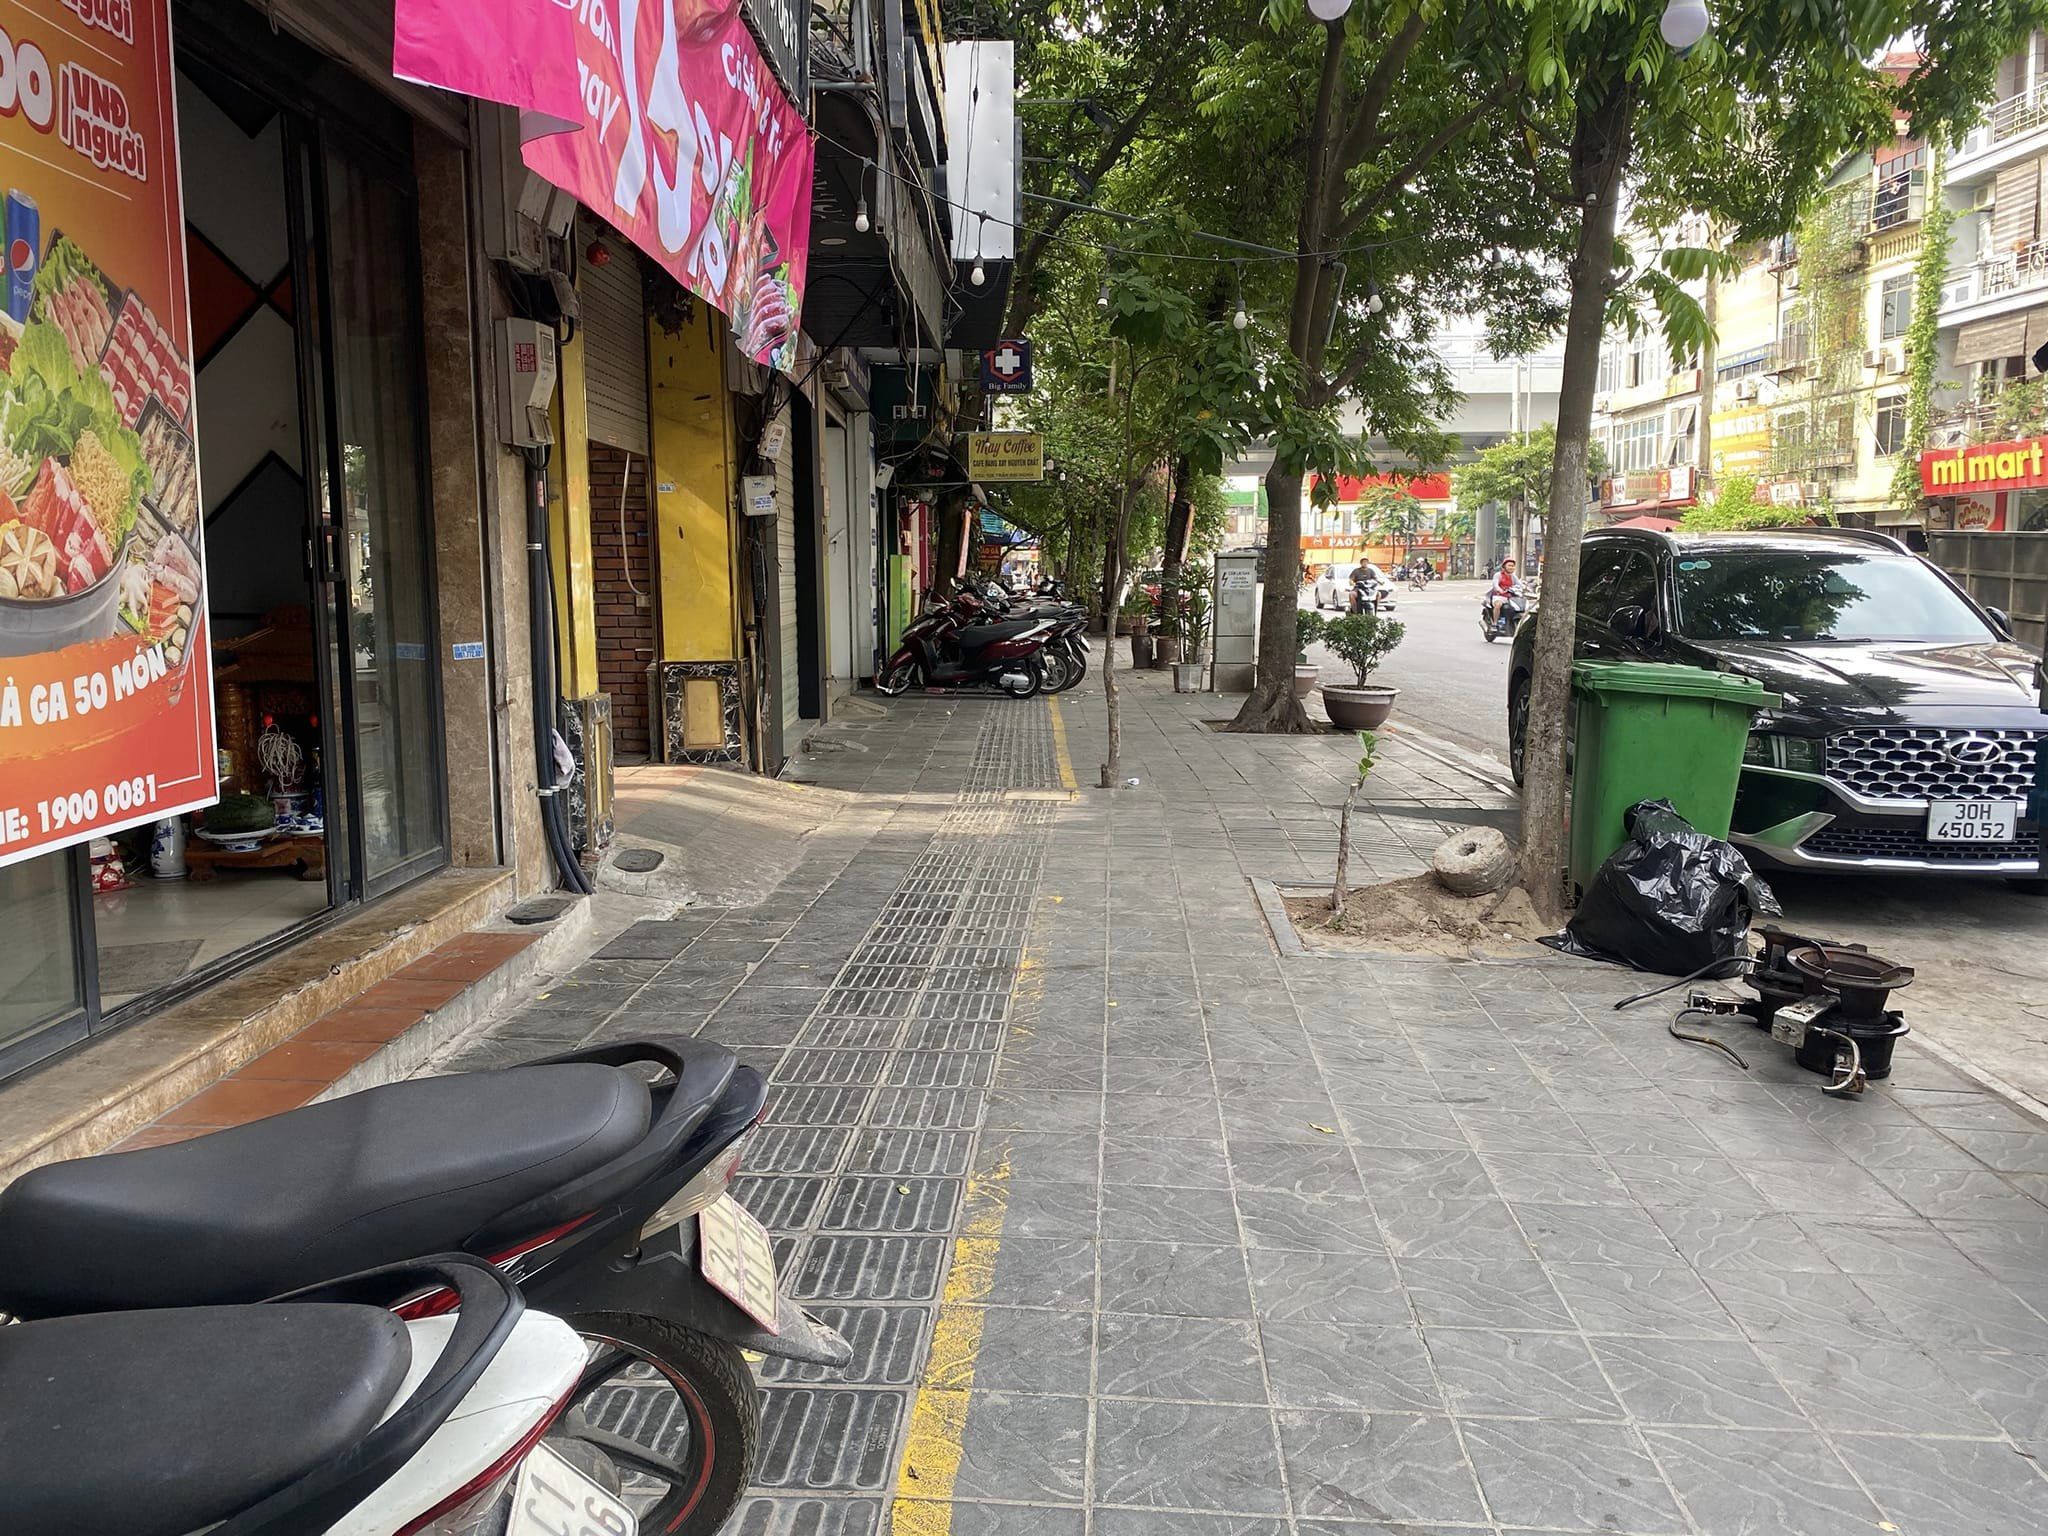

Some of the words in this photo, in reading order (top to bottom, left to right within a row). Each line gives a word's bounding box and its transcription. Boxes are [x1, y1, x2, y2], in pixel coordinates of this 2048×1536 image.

[74, 113, 147, 181] người
[988, 382, 1001, 391] Big
[1003, 382, 1027, 391] Family
[1004, 438, 1036, 456] Coffee
[30, 681, 69, 726] GA
[73, 672, 108, 715] 50
[111, 642, 168, 702] MÓN
[37, 788, 99, 834] 1900
[103, 774, 157, 816] 0081
[1955, 803, 1992, 820] 30H
[1938, 822, 2005, 839] 450.52
